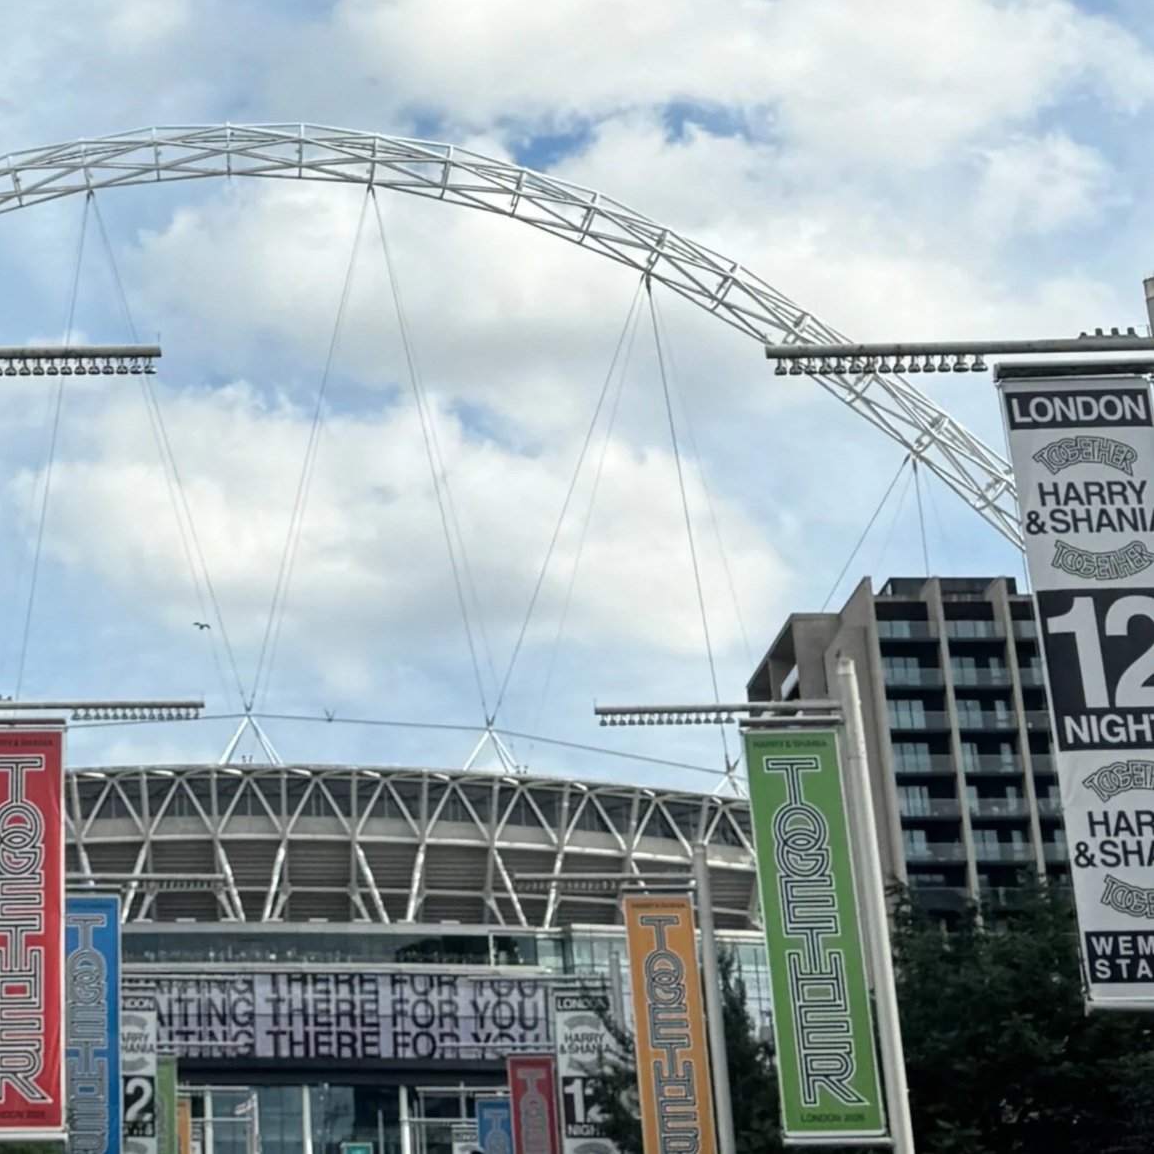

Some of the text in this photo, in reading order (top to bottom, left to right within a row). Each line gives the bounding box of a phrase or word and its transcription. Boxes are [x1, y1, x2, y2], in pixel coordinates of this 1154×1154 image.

[1011, 394, 1146, 423] LONDON
[1032, 435, 1138, 477] TOGETHER
[1038, 480, 1147, 507] HARRY
[1047, 595, 1154, 709] 12
[1064, 713, 1154, 745] NIGH
[762, 756, 871, 1106] TOGETHER
[265, 998, 380, 1027] THERE
[392, 999, 459, 1028] FOR
[471, 1000, 538, 1030] YOU
